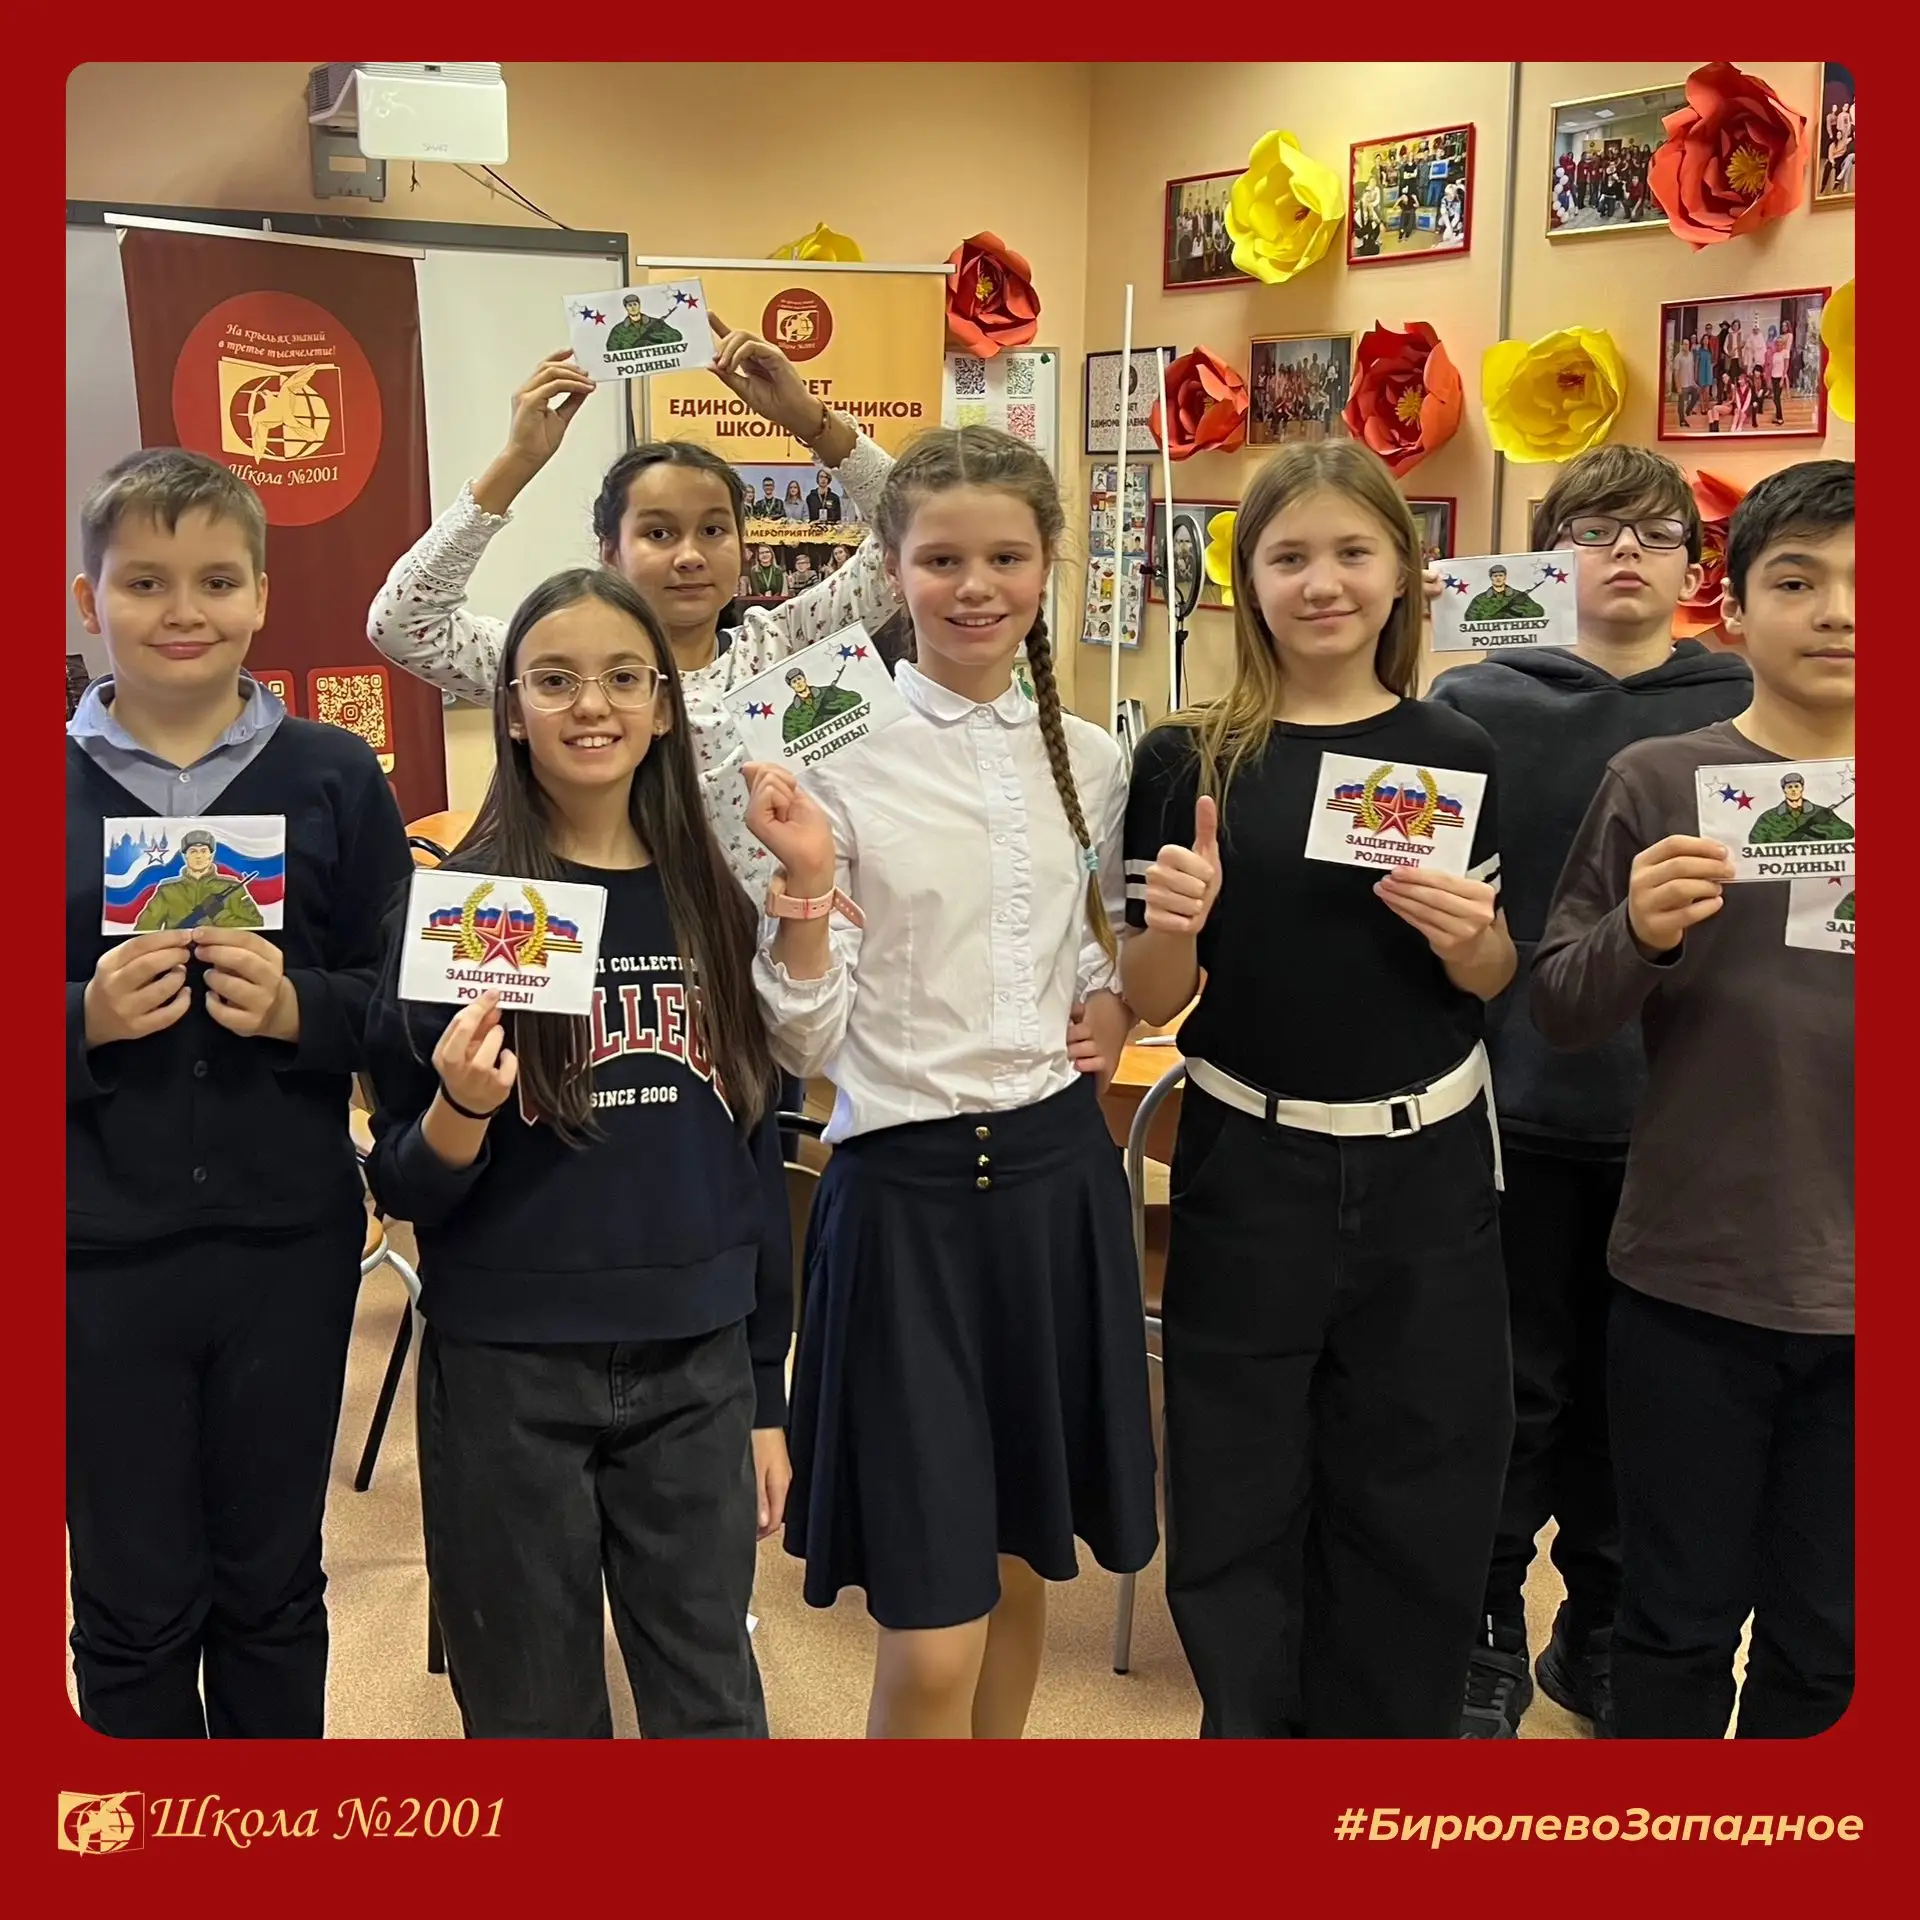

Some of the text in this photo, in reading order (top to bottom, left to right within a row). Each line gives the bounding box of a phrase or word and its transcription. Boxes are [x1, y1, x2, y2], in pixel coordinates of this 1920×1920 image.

[603, 342, 688, 363] ЗАЩИТНИКУ
[616, 357, 681, 376] РОДИНЫ!
[229, 463, 339, 486] Школа №2001
[1459, 618, 1550, 633] ЗАЩИТНИКУ
[1472, 634, 1538, 647] РОДИНЫ!
[783, 701, 872, 758] ЗАЩИТНИКУ
[801, 723, 871, 767] РОДИНЫ!
[1345, 834, 1436, 856] ЗАЩИТНИКУ
[1354, 850, 1421, 868] РОДИНЫ!
[1758, 860, 1846, 875] РОДИНЫ!
[446, 968, 551, 988] ЗАЩИТНИКУ
[590, 1086, 679, 1108] SINCE 2006
